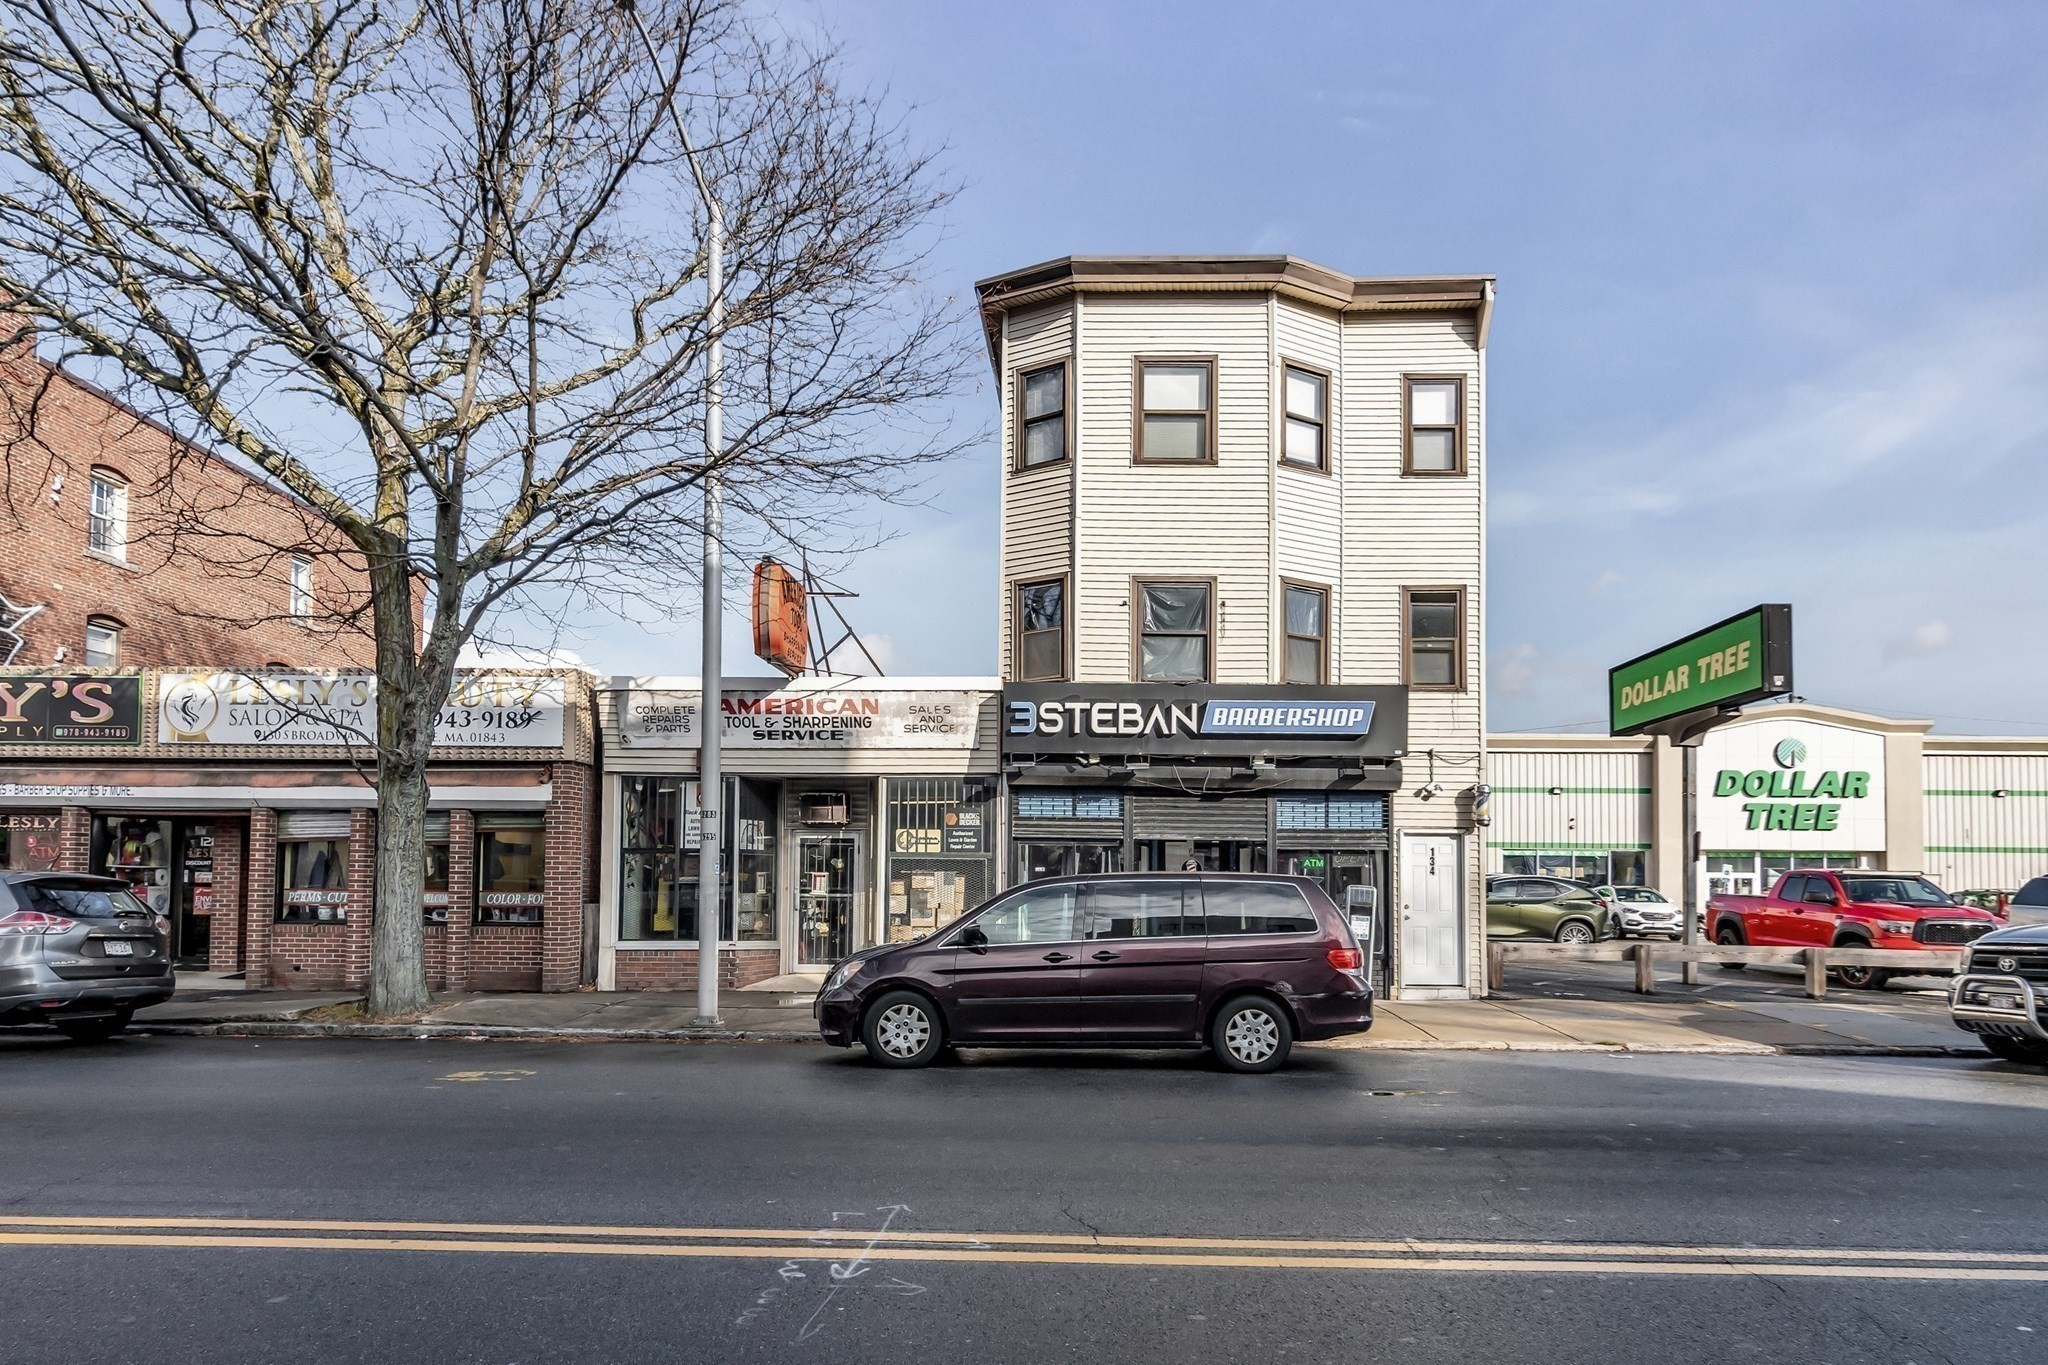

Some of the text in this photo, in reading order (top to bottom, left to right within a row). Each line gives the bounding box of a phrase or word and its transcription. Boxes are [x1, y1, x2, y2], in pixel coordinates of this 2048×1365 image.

[1620, 640, 1751, 711] DOLLAR TREE
[229, 678, 368, 706] LESLY'S
[635, 705, 696, 715] COMPLETE
[721, 698, 878, 715] AMERICAN
[908, 705, 951, 715] SALES
[228, 708, 299, 726] SALON
[327, 709, 363, 726] SPA
[642, 715, 690, 724] REPAIRS
[724, 716, 872, 729] TOOL & SHARPENING
[919, 715, 944, 724] AND
[1211, 706, 1364, 728] BARBERSHOP
[63, 728, 127, 737] 978-943-9189
[644, 724, 691, 734] & PARTS
[753, 729, 844, 741] SERVICE
[904, 724, 955, 734] SERVICE
[1713, 770, 1870, 798] DOLLAR
[1742, 803, 1841, 831] TREE
[1303, 858, 1325, 868] ATM
[287, 892, 322, 903] PERMS
[486, 893, 521, 905] COLOR
